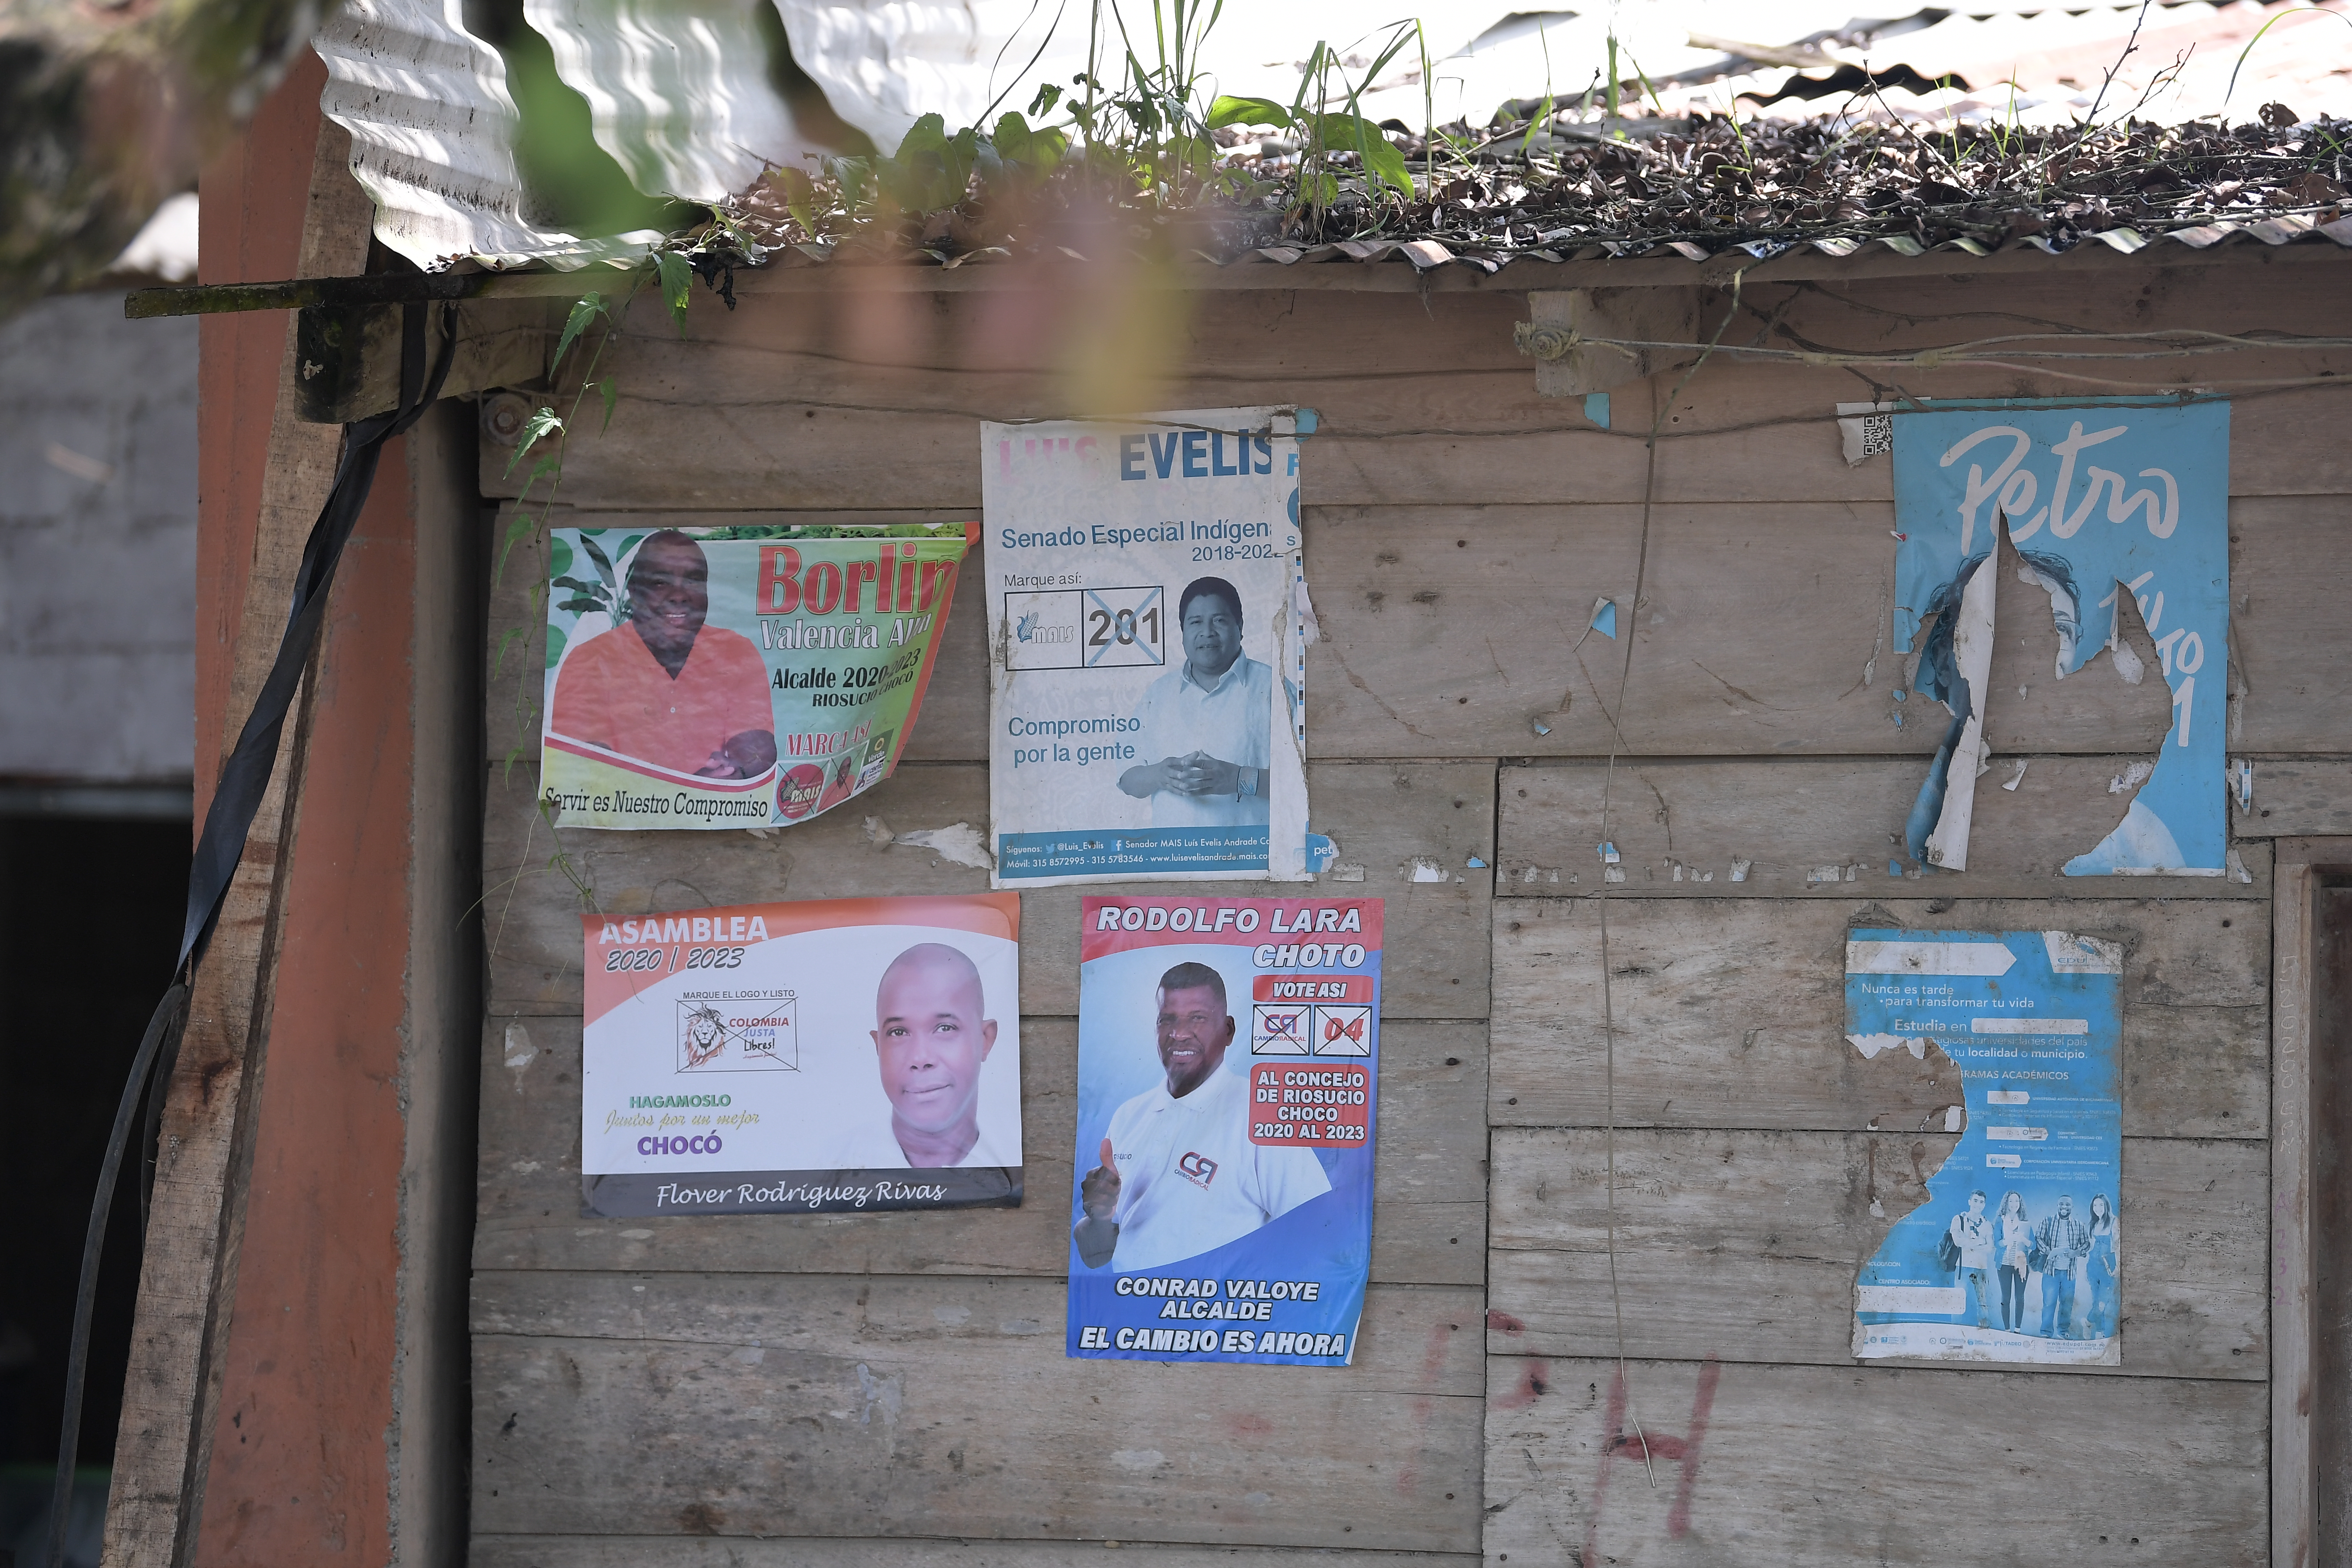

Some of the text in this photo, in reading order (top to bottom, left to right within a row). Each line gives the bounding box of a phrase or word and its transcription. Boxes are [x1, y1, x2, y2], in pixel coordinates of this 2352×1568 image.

[1120, 427, 1271, 481] EVELIS
[1939, 421, 2179, 556] Petro
[1002, 519, 1271, 549] Senado Especial Indígen
[1192, 544, 1284, 561] 2018-202
[1004, 572, 1082, 589] Marque así:
[761, 618, 879, 650] Valencia
[1088, 607, 1159, 646] 201
[772, 648, 921, 689] Alcalde 2020-2023
[812, 668, 914, 707] RIOSUCIO CHOCÓ
[1008, 714, 1141, 739] Compromiso
[785, 730, 849, 756] MARCA
[868, 751, 885, 762] Verde
[1014, 742, 1135, 768] por la gente
[545, 787, 590, 811] Servir
[593, 796, 610, 812] es
[612, 790, 670, 814] Nuestro
[674, 792, 768, 822] Compromiso
[1006, 845, 1043, 855] Síguenos:
[1057, 841, 1104, 852] @Luis_Evelis
[1126, 840, 1158, 848] Senador
[1160, 839, 1182, 847] MAIS
[1184, 838, 1198, 847] Luís
[1201, 838, 1221, 847] Evelis
[1224, 837, 1257, 846] Andrade
[1007, 860, 1030, 868] Móvil:
[1033, 859, 1046, 867] 315
[1050, 857, 1084, 866] 8572995
[1092, 856, 1105, 864] 315
[1108, 853, 1143, 863] 5783546
[1097, 906, 1361, 933] RODOLFO LARA
[599, 916, 769, 945] ASAMBLEA
[605, 947, 663, 972] 2020
[686, 947, 745, 970] 2023
[1252, 943, 1366, 969] CHOTO
[683, 991, 720, 999] MARQUE
[770, 989, 795, 997] LISTO
[1273, 982, 1347, 999] VOTE ASI
[1862, 983, 1900, 994] Nunca
[1922, 984, 1954, 995] tarde
[1886, 996, 2034, 1009] para transformar tu vida
[729, 1017, 789, 1027] COLOMBIA
[1324, 1017, 1364, 1041] 04
[1895, 1018, 1966, 1032] Estudia en
[744, 1029, 775, 1037] JUSTA
[2048, 1035, 2063, 1046] del
[2067, 1036, 2087, 1048] país
[744, 1038, 775, 1051] Libres!
[1955, 1048, 1965, 1056] tu
[1968, 1047, 2018, 1057] localidad
[2031, 1047, 2088, 1061] municipio.
[1258, 1071, 1365, 1088] AL CONCEJO
[2002, 1070, 2069, 1080] ACADÉMICOS
[629, 1094, 731, 1109] HAGAMOSLO
[1256, 1088, 1365, 1105] DE RIOSUCIO
[604, 1110, 760, 1134] Juntos por un mejor
[1277, 1106, 1338, 1122] CHOCO
[637, 1129, 722, 1155] CHOCÓ
[1254, 1123, 1365, 1140] 2020 AL 2023
[656, 1182, 732, 1208] Flover
[1115, 1277, 1320, 1301] CONRAD VALOYE
[1160, 1300, 1273, 1321] ALCALDE
[1080, 1327, 1345, 1356] EL CAMBIO ES AHORA
